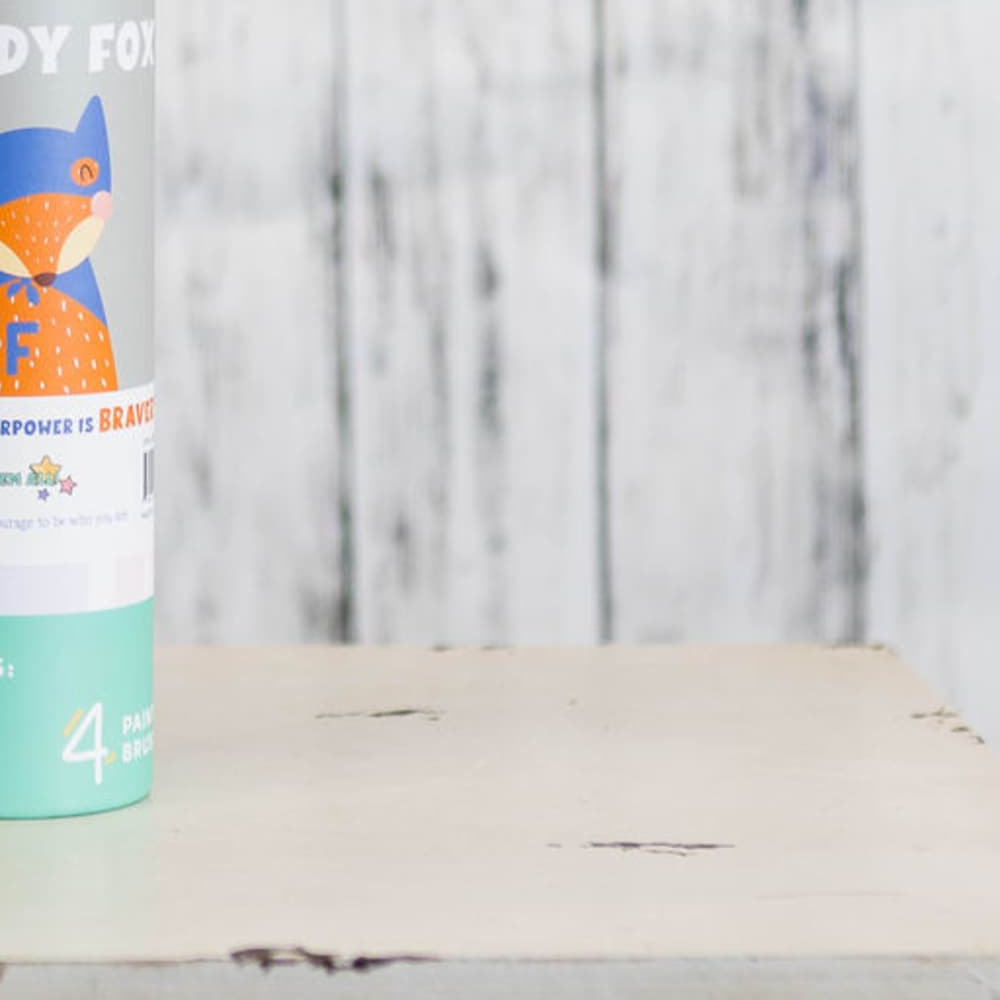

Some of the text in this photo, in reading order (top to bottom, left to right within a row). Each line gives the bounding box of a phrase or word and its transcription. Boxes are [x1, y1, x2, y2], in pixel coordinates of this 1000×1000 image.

[87, 19, 155, 74] FOX
[5, 322, 40, 376] F
[79, 416, 94, 433] IS
[62, 701, 110, 785] 4
[122, 706, 152, 735] PAIN
